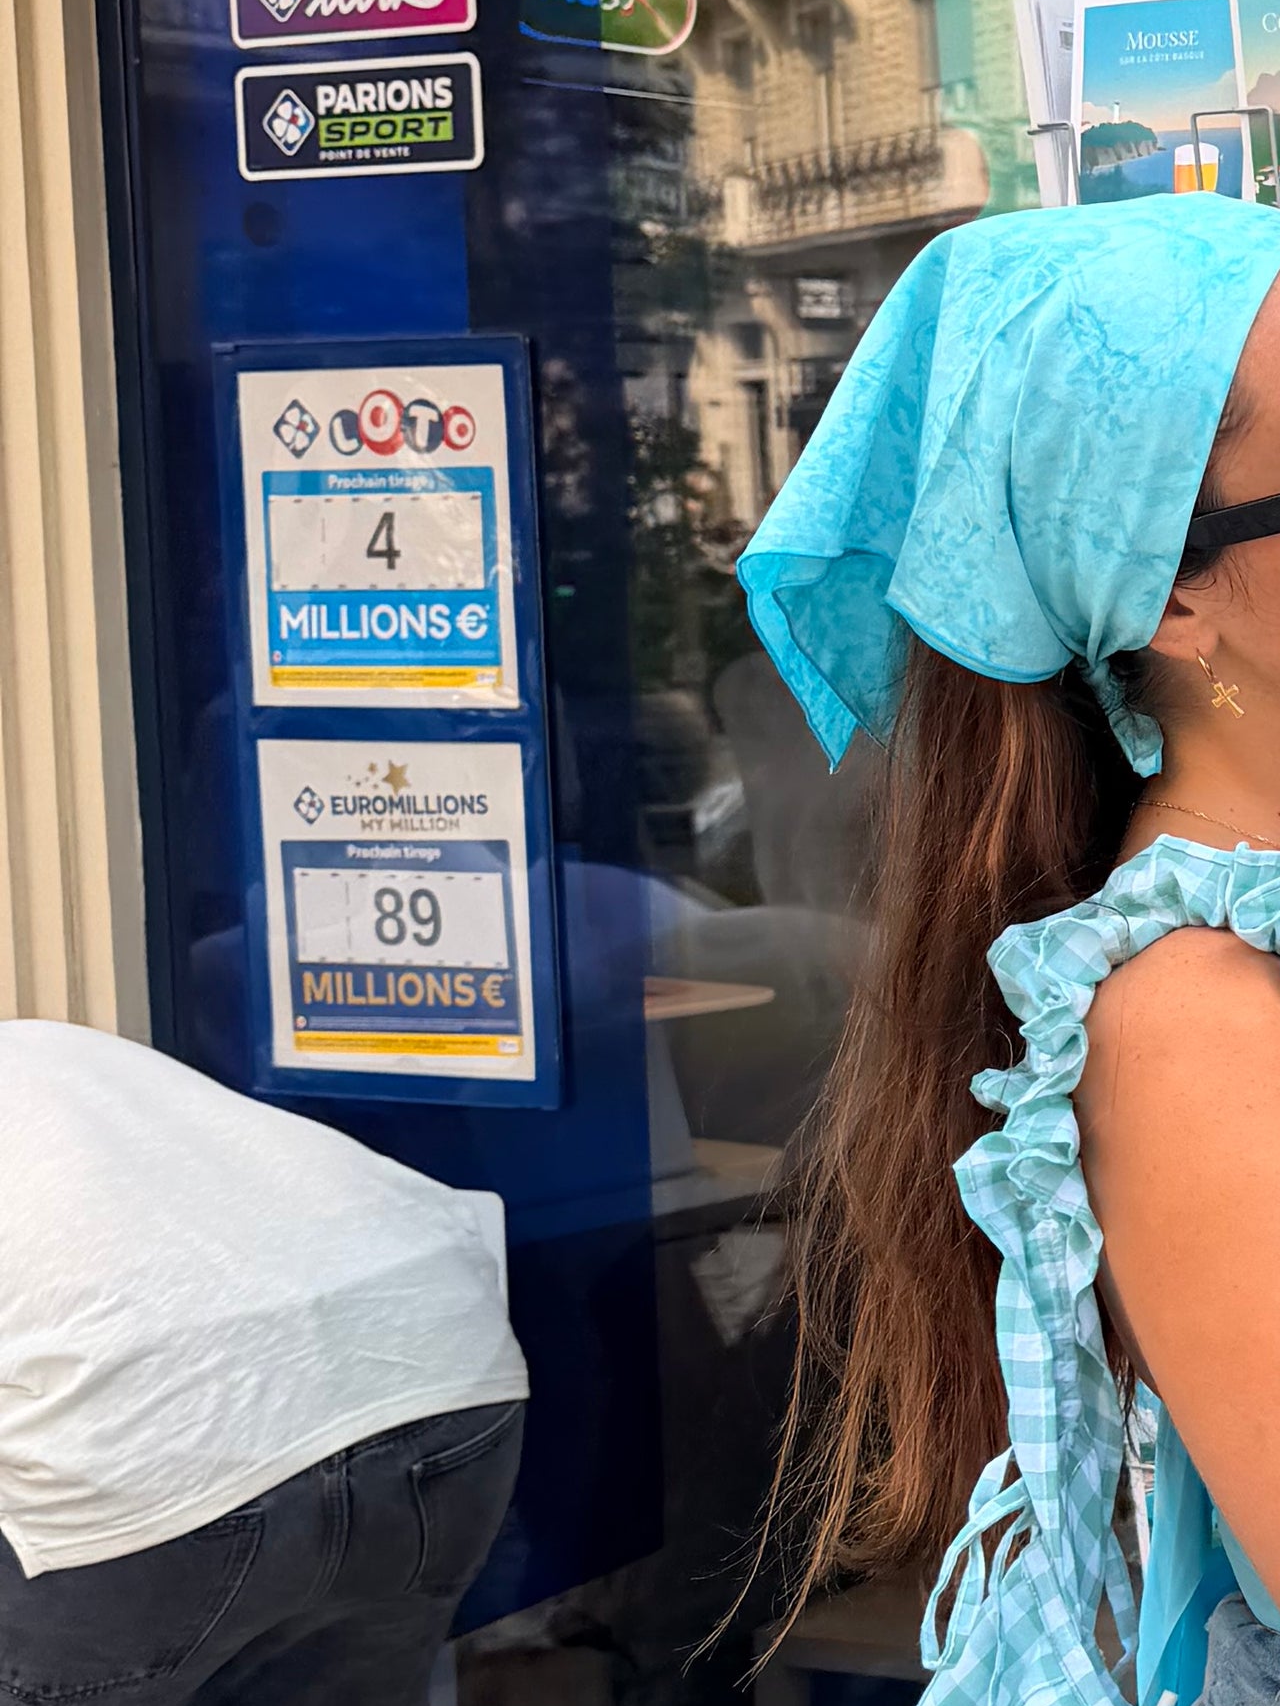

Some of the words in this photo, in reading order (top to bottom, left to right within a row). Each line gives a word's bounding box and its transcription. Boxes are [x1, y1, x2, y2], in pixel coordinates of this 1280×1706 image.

[1124, 29, 1199, 52] MOUSSE
[316, 76, 453, 116] PARIONS
[325, 116, 448, 143] SPORT
[318, 148, 353, 161] POINT
[355, 148, 371, 160] DE
[373, 146, 410, 159] VENTE
[329, 389, 476, 456] LOTO
[366, 511, 401, 571] 4
[279, 603, 451, 640] MILLIONS
[331, 793, 489, 817] EUROMILLIONS
[373, 887, 443, 947] 89
[302, 971, 477, 1007] MILLIONS
